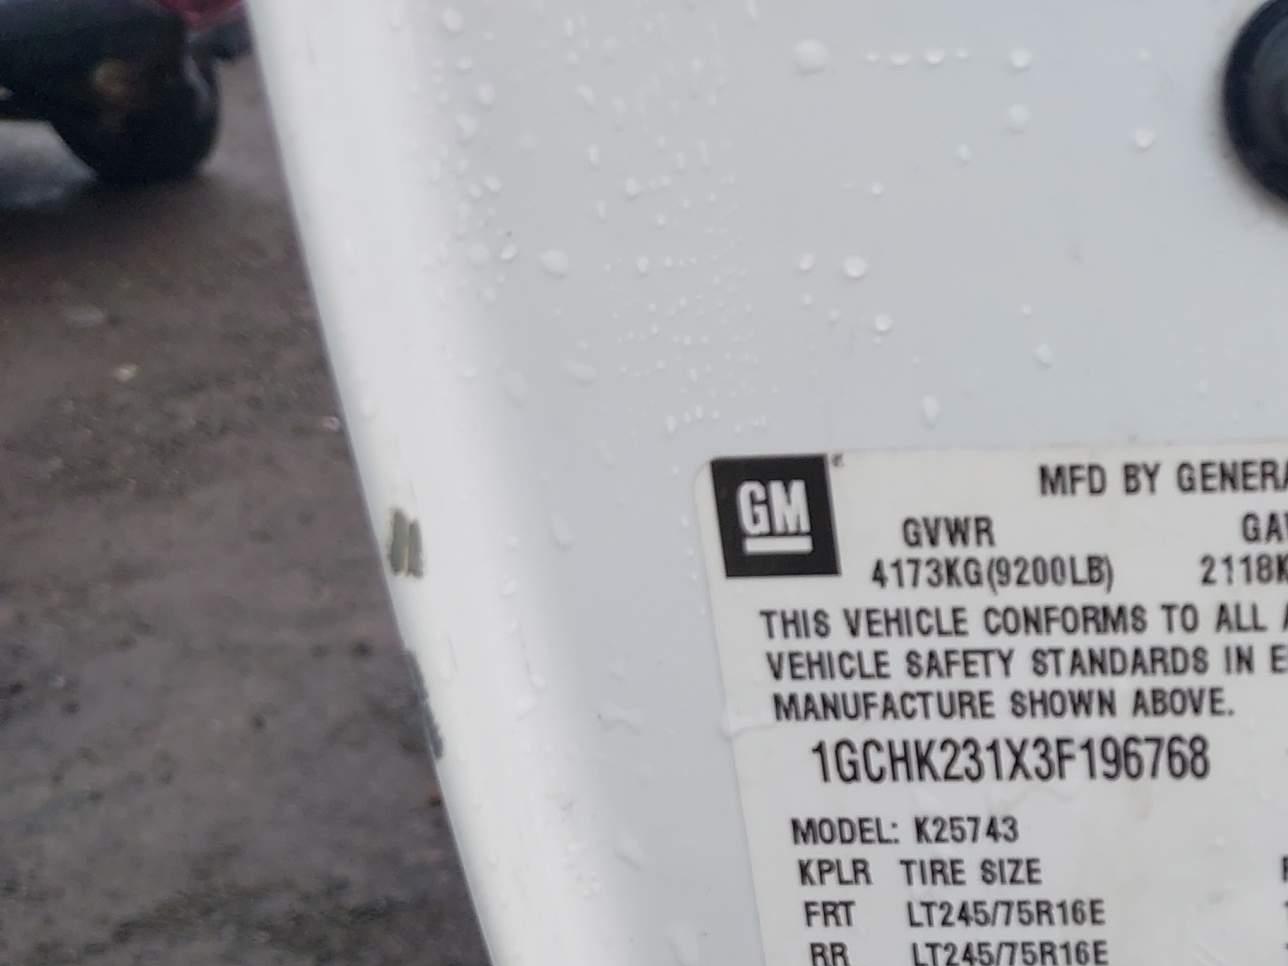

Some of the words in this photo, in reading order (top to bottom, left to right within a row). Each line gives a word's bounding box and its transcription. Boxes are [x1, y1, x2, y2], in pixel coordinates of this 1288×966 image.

[1040, 463, 1106, 497] MFD
[1124, 462, 1160, 495] BY
[737, 479, 811, 537] GM
[903, 516, 996, 549] GVWR
[871, 553, 1115, 594] 4173KG(9200LB)
[760, 608, 832, 641] THIS
[843, 605, 970, 639] VEHICLE
[983, 603, 1148, 637] CONFORMS
[1161, 602, 1199, 634] TO
[1215, 601, 1269, 634] ALL
[765, 649, 892, 682] VEHICLE
[905, 647, 1016, 679] SAFETY
[1031, 645, 1210, 677] STANDARDS
[1224, 644, 1255, 675] IN
[772, 689, 996, 722] MANUFACTURE
[1010, 687, 1118, 718] SHOWN
[1132, 686, 1235, 717] ABOVE.
[811, 736, 1212, 785] 1GCHK231X3F196768
[791, 817, 900, 845] MODEL:
[914, 816, 1020, 844] K25743
[798, 858, 873, 887] KPLR
[899, 858, 966, 887] TIRE
[980, 857, 1043, 885] SIZE
[804, 900, 856, 928] FRT
[908, 899, 1106, 927] LT245/75R16E
